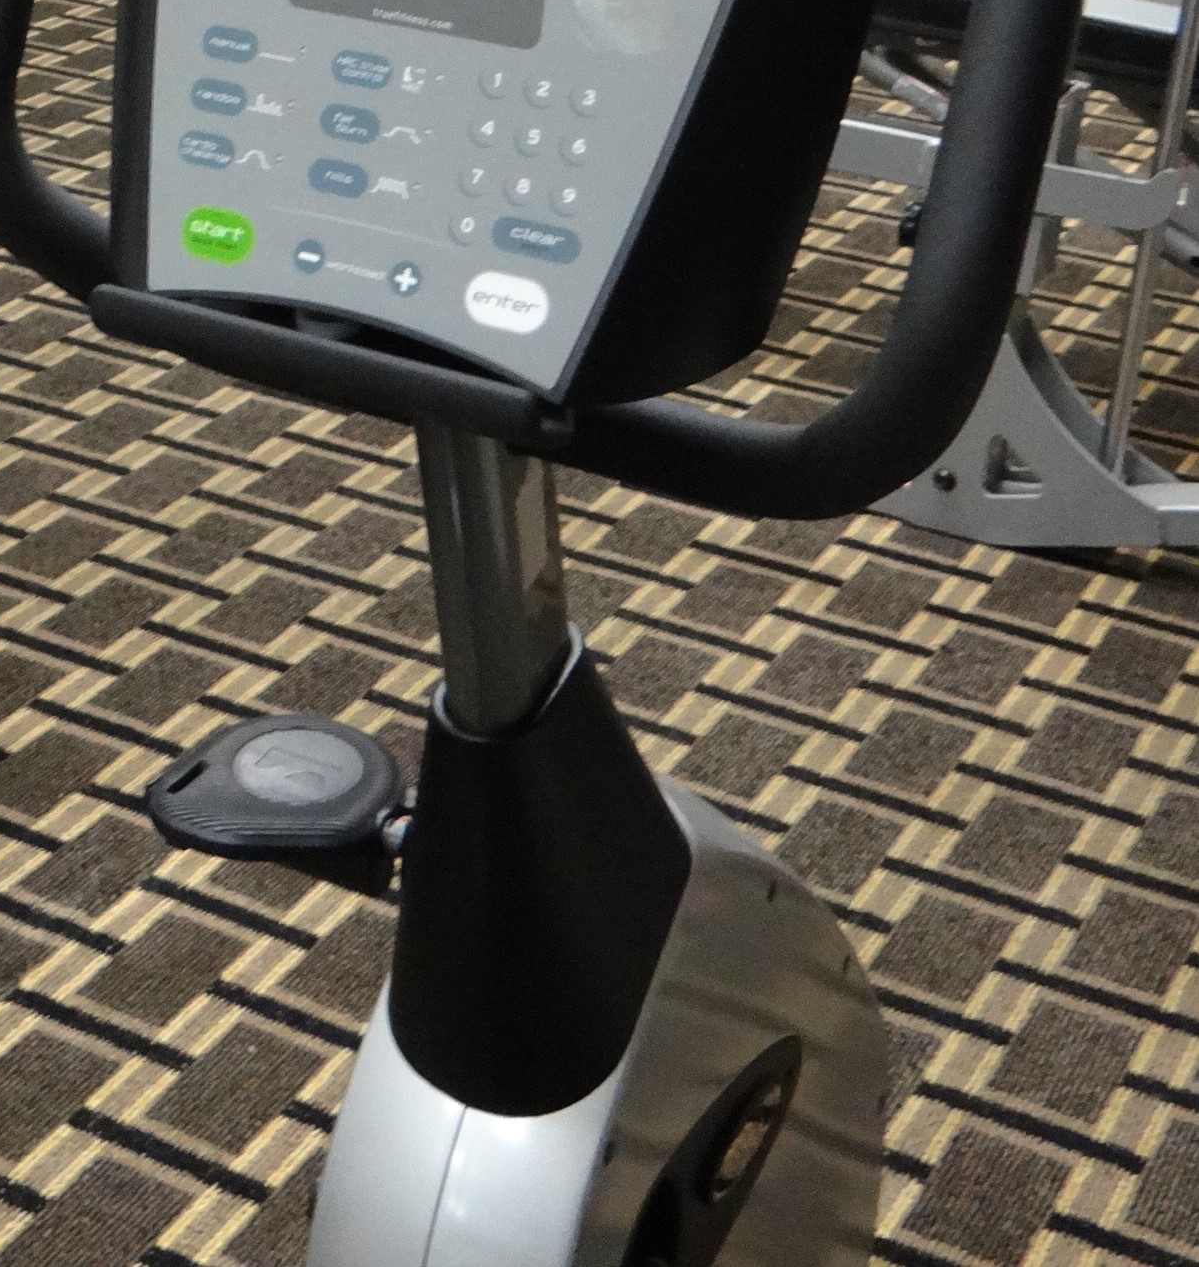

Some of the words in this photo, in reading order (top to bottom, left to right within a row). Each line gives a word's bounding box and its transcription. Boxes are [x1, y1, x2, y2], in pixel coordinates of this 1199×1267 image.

[493, 72, 503, 88] 1
[535, 80, 552, 98] 2
[581, 89, 597, 107] 3
[480, 119, 496, 136] 4
[526, 128, 542, 146] 5
[571, 138, 587, 154] 6
[471, 167, 485, 184] 7
[515, 178, 531, 195] 8
[562, 187, 577, 204] 9
[189, 219, 245, 242] start
[460, 217, 475, 233] 0
[509, 226, 567, 246] clear
[471, 290, 542, 313] enter
